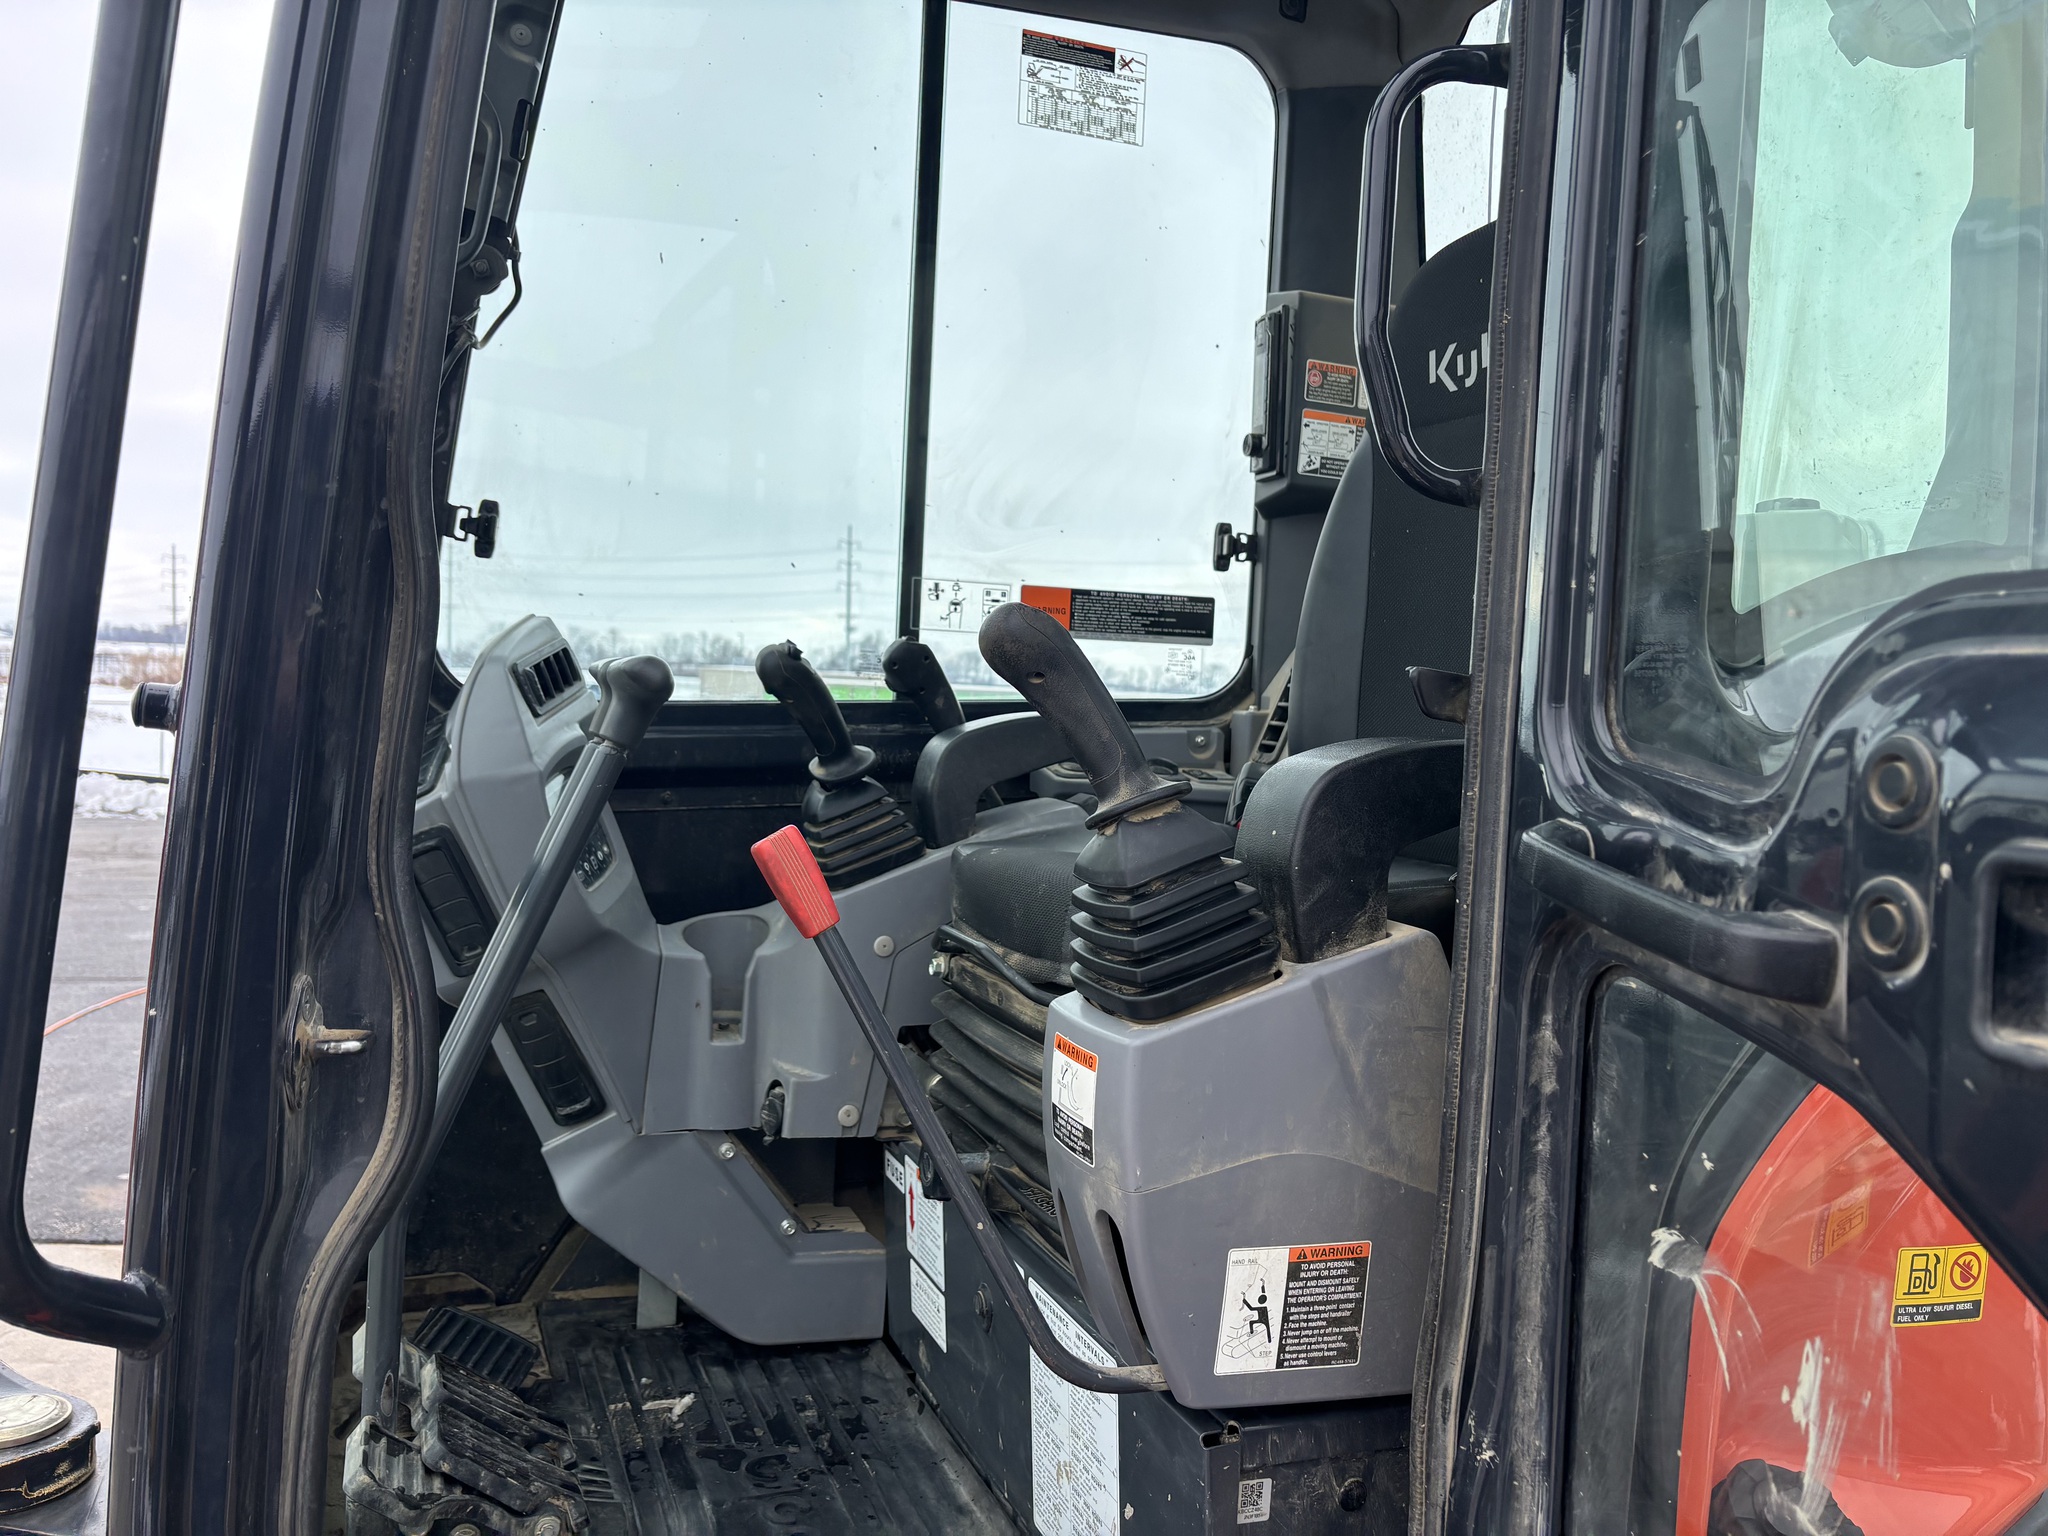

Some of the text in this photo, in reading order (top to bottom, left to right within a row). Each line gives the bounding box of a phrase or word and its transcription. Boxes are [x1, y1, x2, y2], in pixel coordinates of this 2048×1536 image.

[1063, 1040, 1093, 1068] WARNING
[887, 1158, 903, 1186] FUSE
[1311, 1246, 1363, 1258] WARNING
[1327, 1260, 1355, 1268] PERSONAL
[1303, 1287, 1326, 1295] ENTERING
[1934, 1304, 1954, 1312] SULFUR
